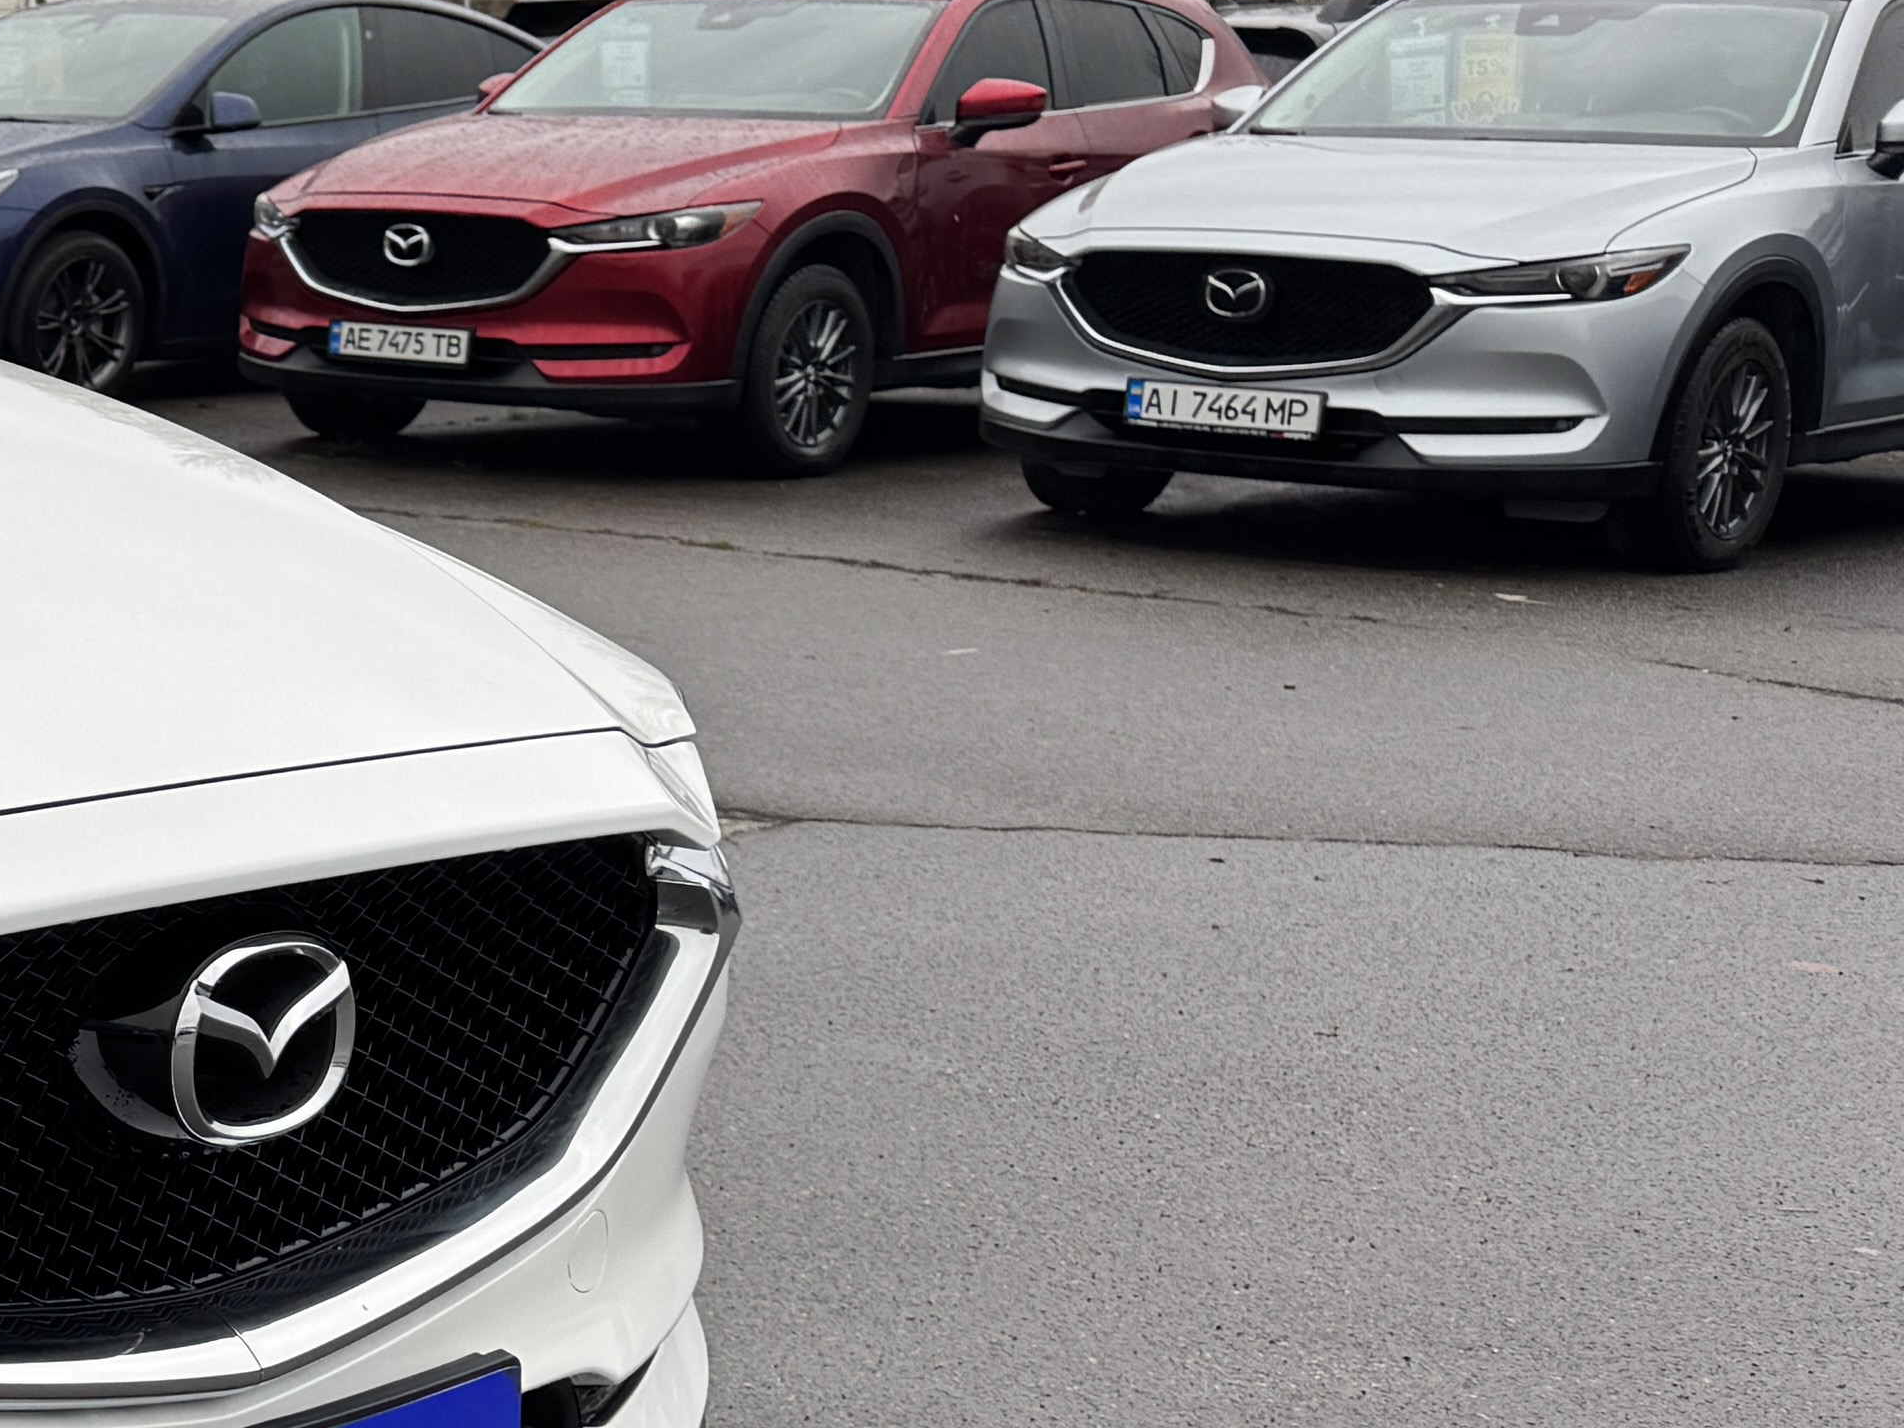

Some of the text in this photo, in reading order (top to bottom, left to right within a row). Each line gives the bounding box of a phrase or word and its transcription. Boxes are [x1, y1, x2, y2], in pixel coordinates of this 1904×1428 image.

[343, 327, 461, 358] AE 7475 TB
[1144, 387, 1309, 426] AI 7464 MP
